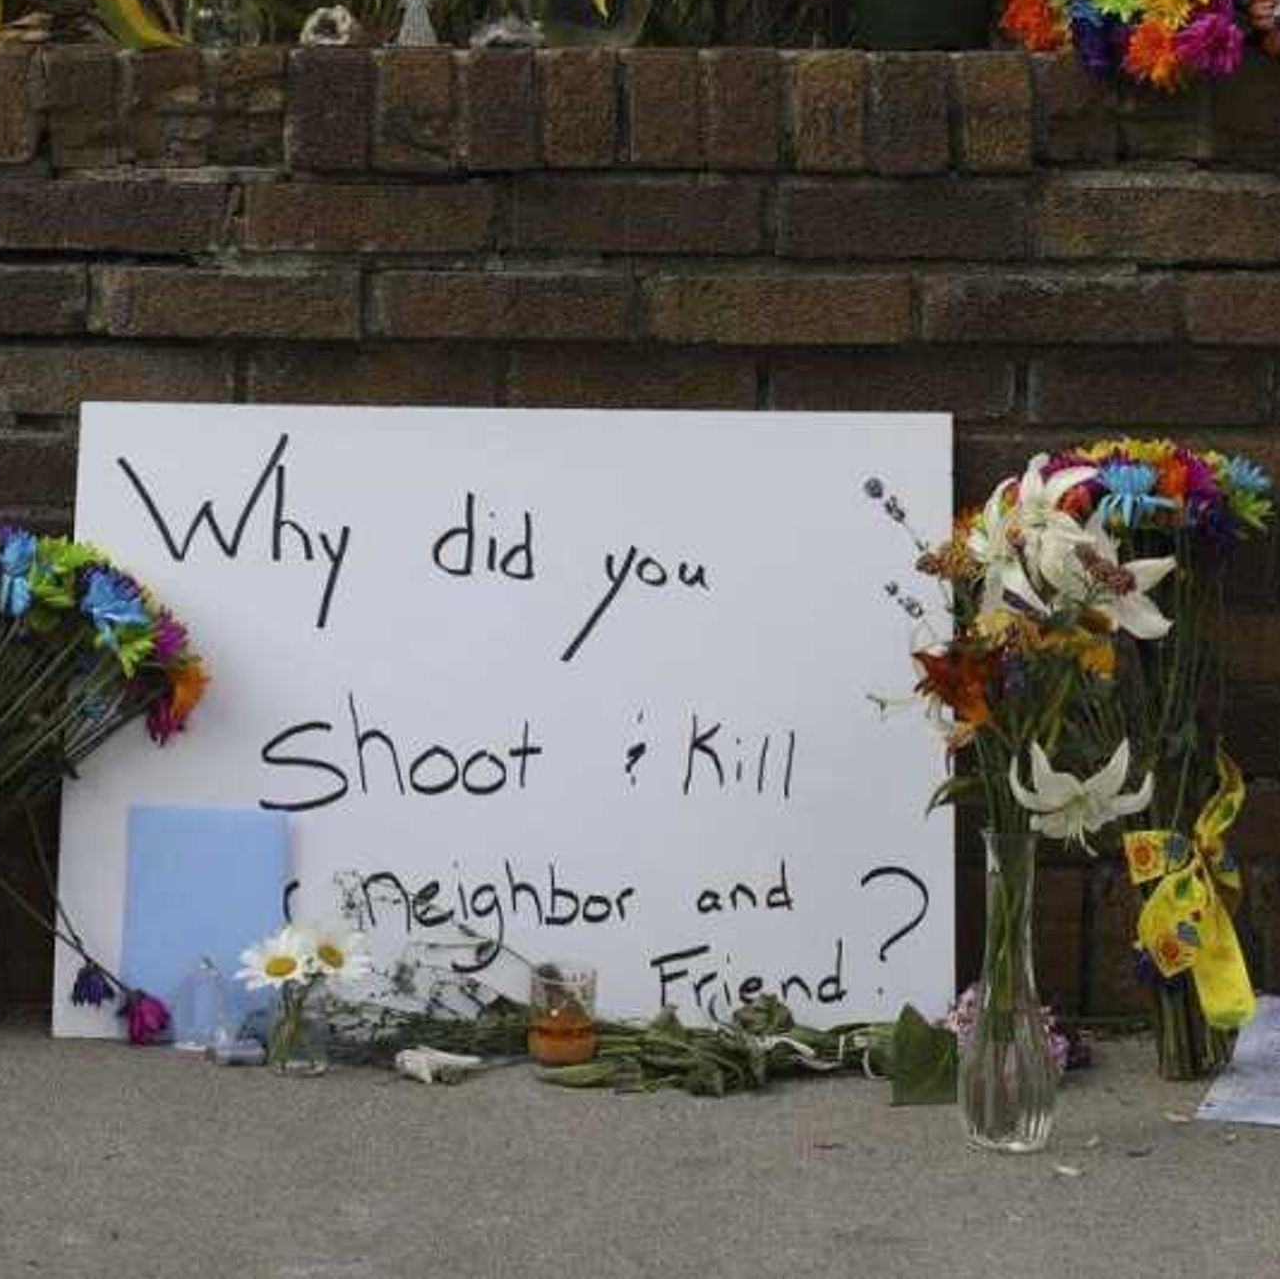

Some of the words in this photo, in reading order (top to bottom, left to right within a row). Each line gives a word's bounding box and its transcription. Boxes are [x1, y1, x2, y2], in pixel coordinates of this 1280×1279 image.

[117, 434, 350, 629] Why
[432, 492, 535, 580] did
[560, 545, 708, 662] you
[696, 860, 794, 914] and
